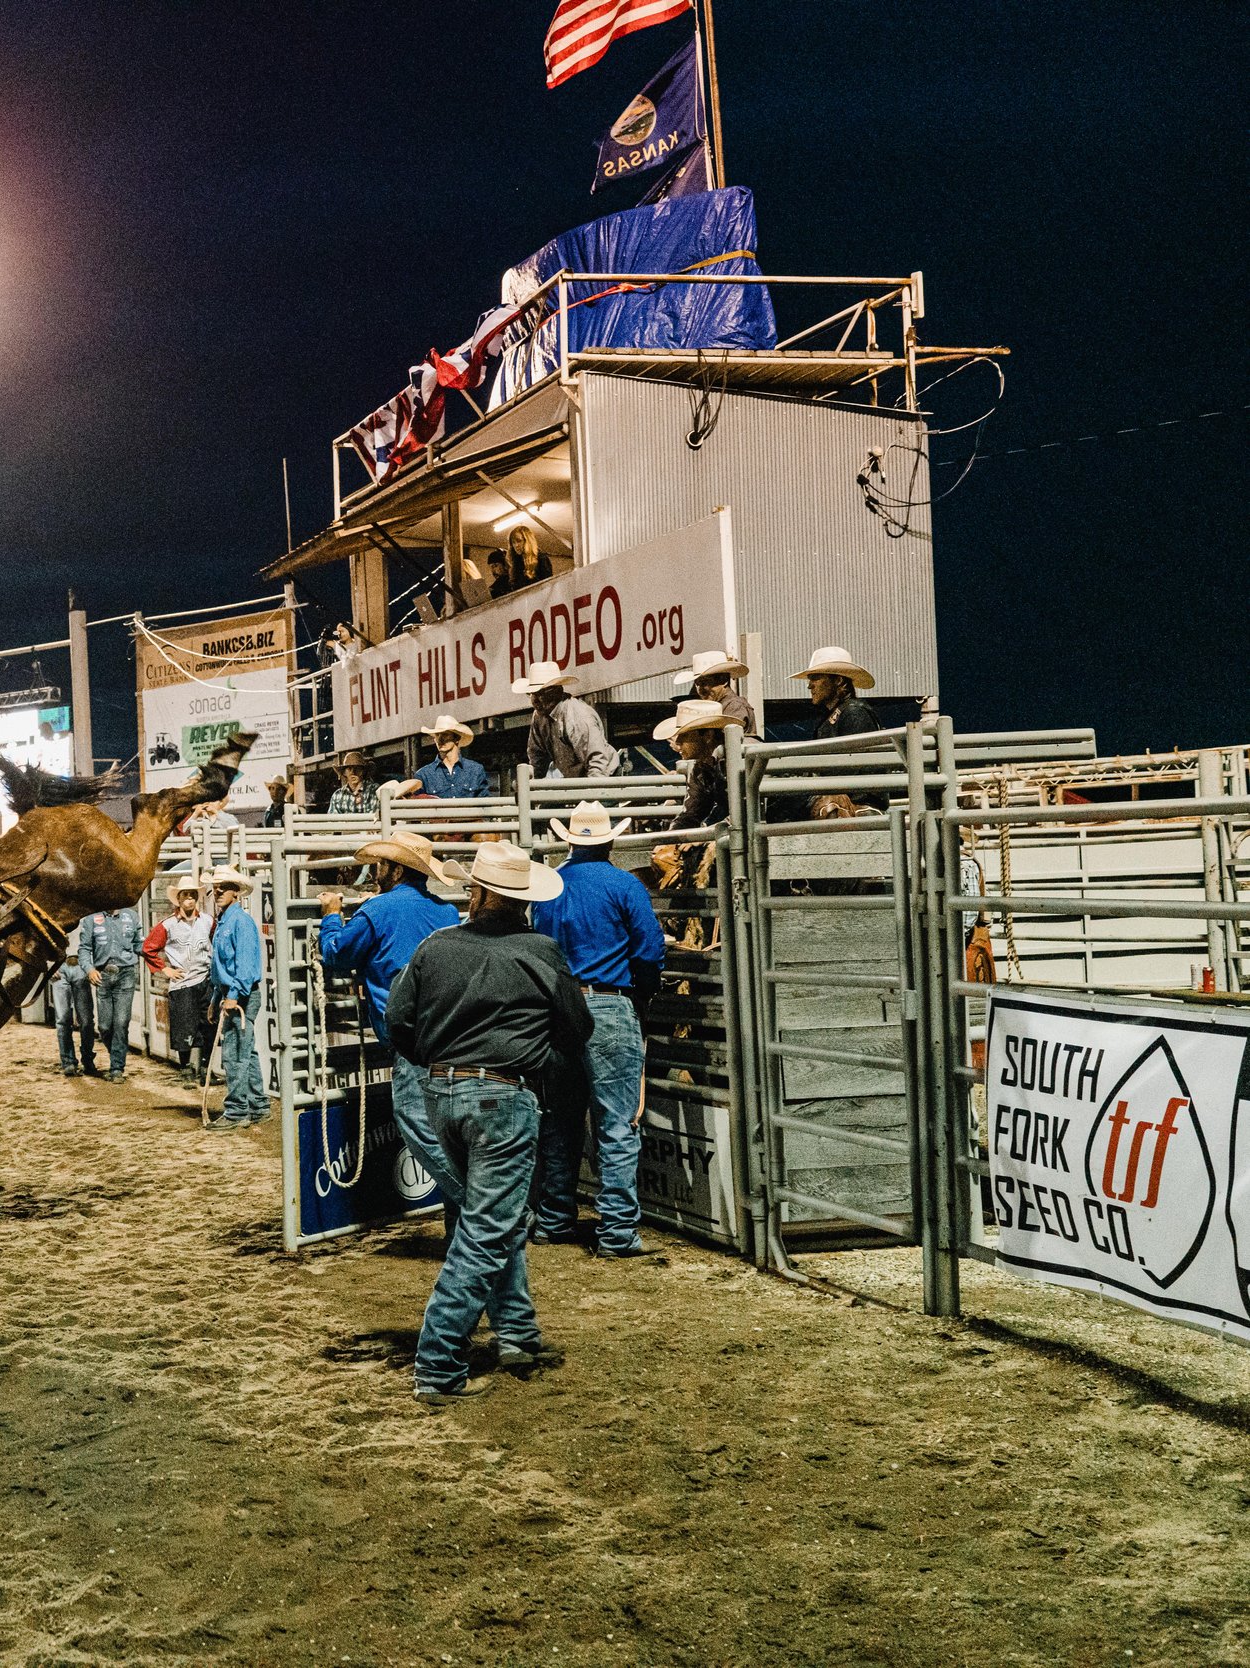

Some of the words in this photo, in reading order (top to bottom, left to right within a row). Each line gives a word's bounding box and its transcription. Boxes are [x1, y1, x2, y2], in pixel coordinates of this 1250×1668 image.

[350, 659, 401, 727] FLINT
[417, 631, 487, 709] HILLS
[509, 584, 622, 684] RODEO
[636, 604, 684, 656] .org
[1000, 1034, 1105, 1103] SOUTH
[641, 1136, 715, 1175] RPHY
[994, 1104, 1071, 1174] FORK
[994, 1174, 1079, 1244] SEED
[1083, 1197, 1146, 1266] CO.
